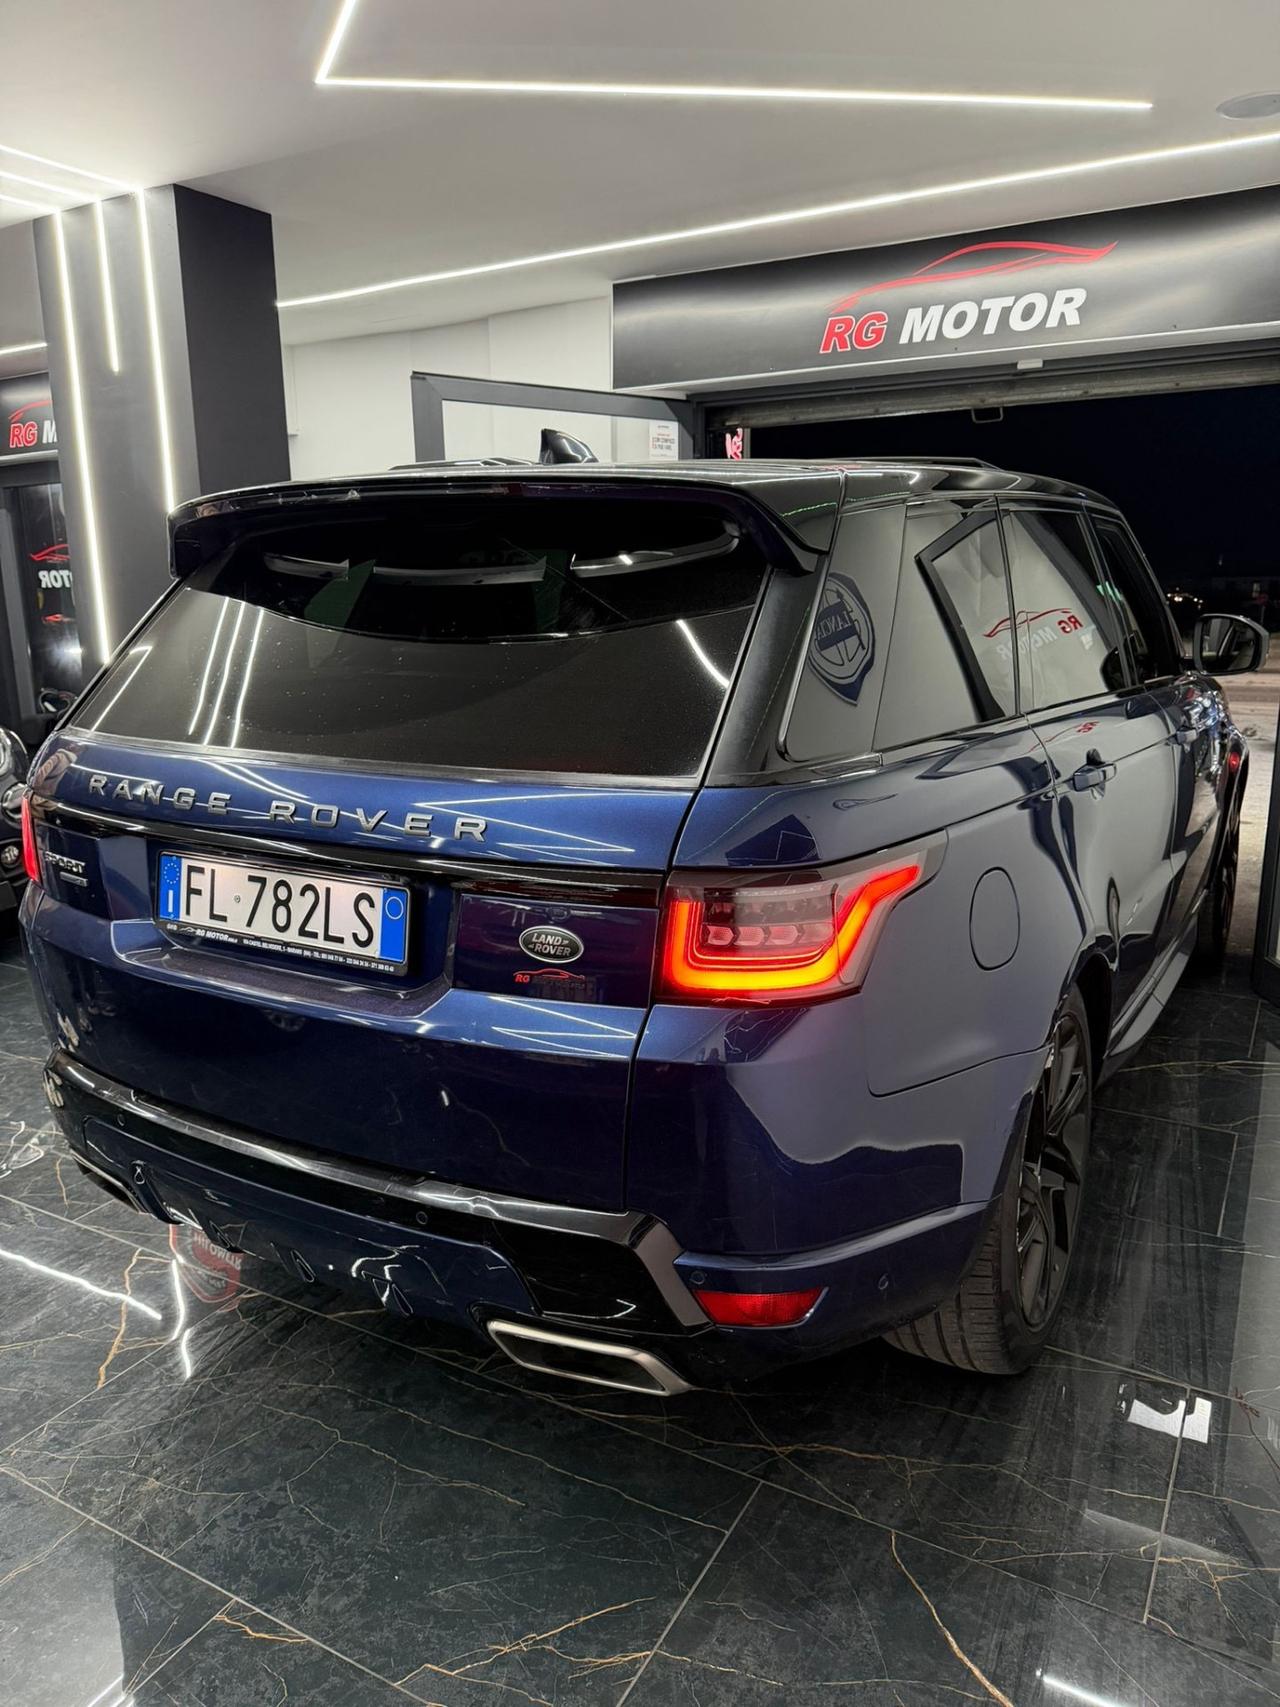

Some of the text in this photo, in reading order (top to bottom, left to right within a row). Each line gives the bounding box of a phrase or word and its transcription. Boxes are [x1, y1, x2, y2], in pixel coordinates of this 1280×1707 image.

[819, 287, 1087, 355] RG MOTOR
[9, 421, 39, 449] RG
[88, 774, 489, 843] RANGE ROVER
[185, 863, 228, 923] FL
[245, 874, 376, 949] 782LS
[531, 932, 562, 946] LAND
[533, 943, 572, 957] ROVER
